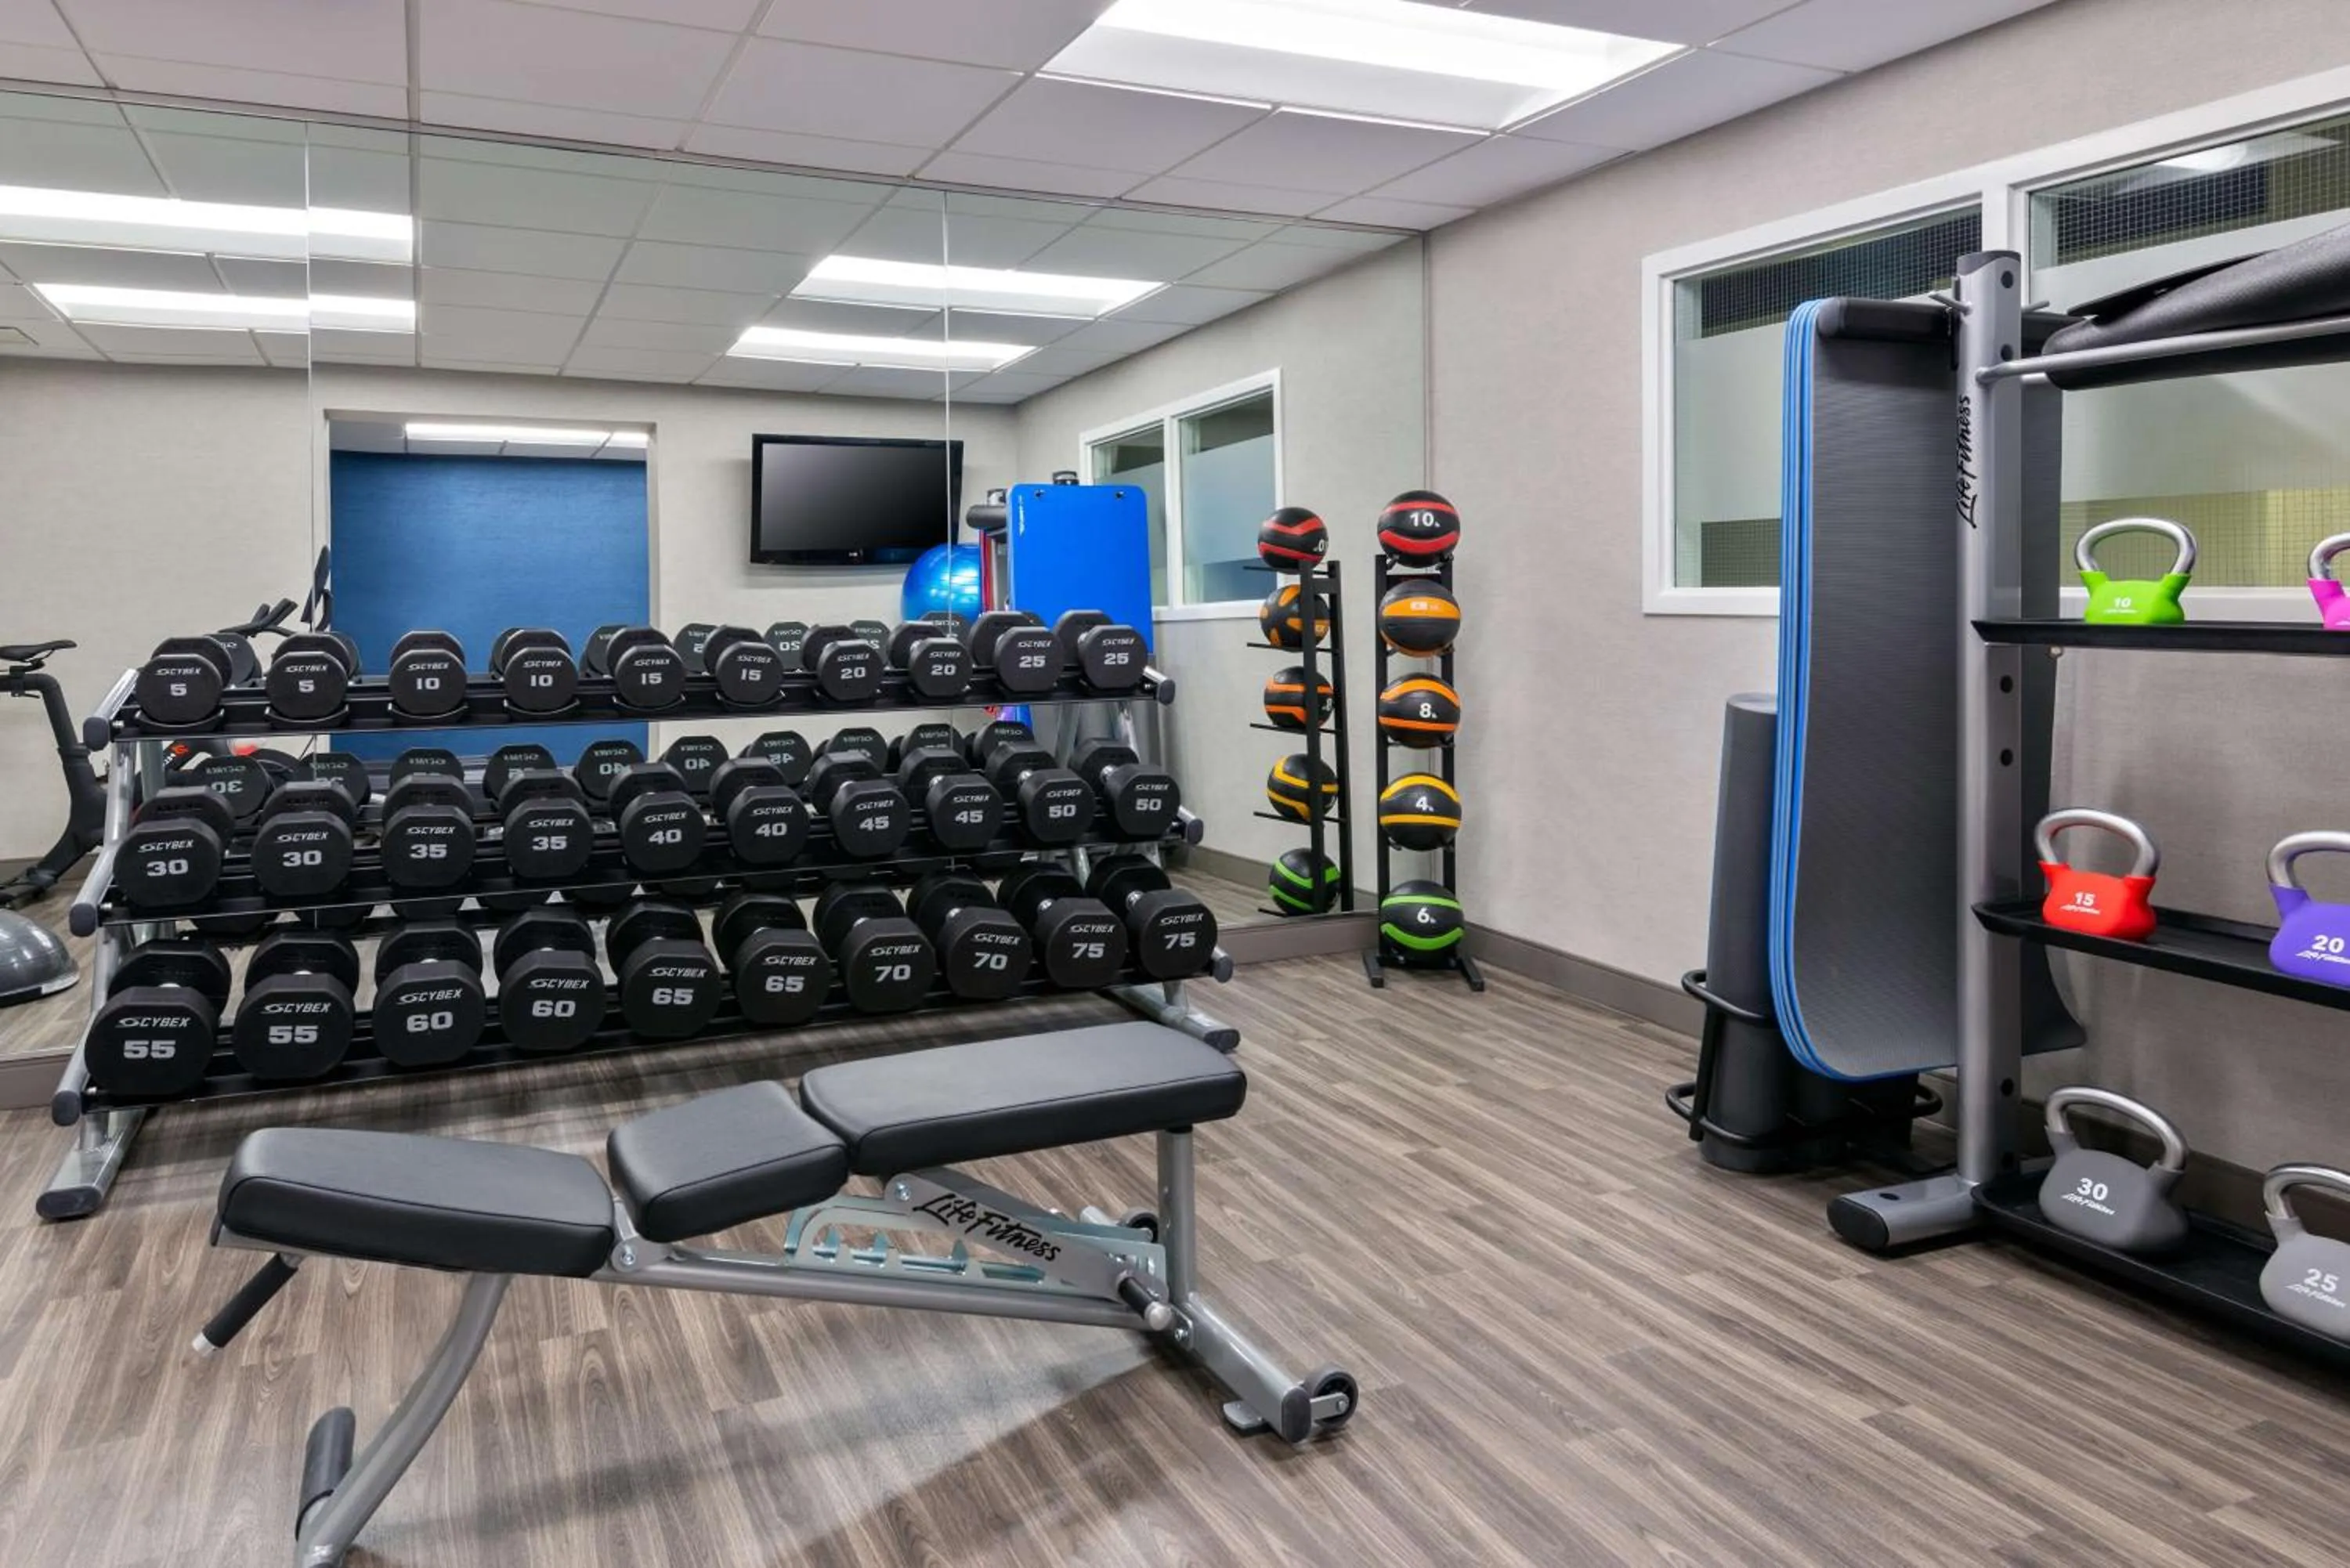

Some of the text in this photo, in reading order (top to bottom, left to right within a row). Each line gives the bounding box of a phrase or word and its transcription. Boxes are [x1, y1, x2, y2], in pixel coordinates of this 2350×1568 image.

[1410, 511, 1434, 528] 10
[2113, 597, 2131, 609] 10
[1018, 655, 1046, 668] 25
[1104, 652, 1130, 665] 25
[740, 668, 762, 681] 15
[841, 667, 866, 680] 20
[931, 663, 956, 676] 20
[298, 679, 315, 693] 5
[416, 677, 440, 690] 10
[530, 674, 553, 687] 10
[641, 672, 662, 685] 15
[170, 683, 187, 696] 5
[1419, 703, 1432, 717] 8
[1048, 804, 1076, 818] 50
[1135, 798, 1162, 811] 50
[1415, 796, 1428, 811] 4
[859, 815, 890, 831] 45
[955, 810, 983, 824] 45
[648, 829, 682, 844] 40
[755, 822, 787, 837] 40
[532, 835, 567, 851] 35
[283, 850, 322, 867] 30
[410, 844, 447, 859] 35
[146, 858, 189, 876] 30
[2074, 891, 2096, 907] 15
[1171, 912, 1204, 926] CYBEX
[1417, 907, 1430, 923] 6
[1082, 924, 1115, 934] CYBEX
[986, 933, 1021, 945] CYBEX
[1164, 931, 1196, 949] 75
[2312, 934, 2345, 953] 20
[883, 944, 921, 956] CYBEX
[1072, 942, 1105, 959] 75
[777, 955, 817, 966] CYBEX
[974, 952, 1008, 970] 70
[664, 966, 707, 978] CYBEX
[875, 964, 911, 982] 70
[546, 978, 590, 989] CYBEX
[765, 975, 805, 992] 65
[418, 988, 463, 1003] CYBEX
[652, 988, 694, 1005] 65
[281, 1002, 331, 1014] CYBEX
[532, 999, 577, 1017] 60
[138, 1017, 191, 1028] CYBEX
[407, 1011, 454, 1032] 60
[268, 1025, 319, 1044] 55
[123, 1039, 176, 1059] 55
[2077, 1177, 2109, 1201] 30
[2303, 1268, 2340, 1293] 25
